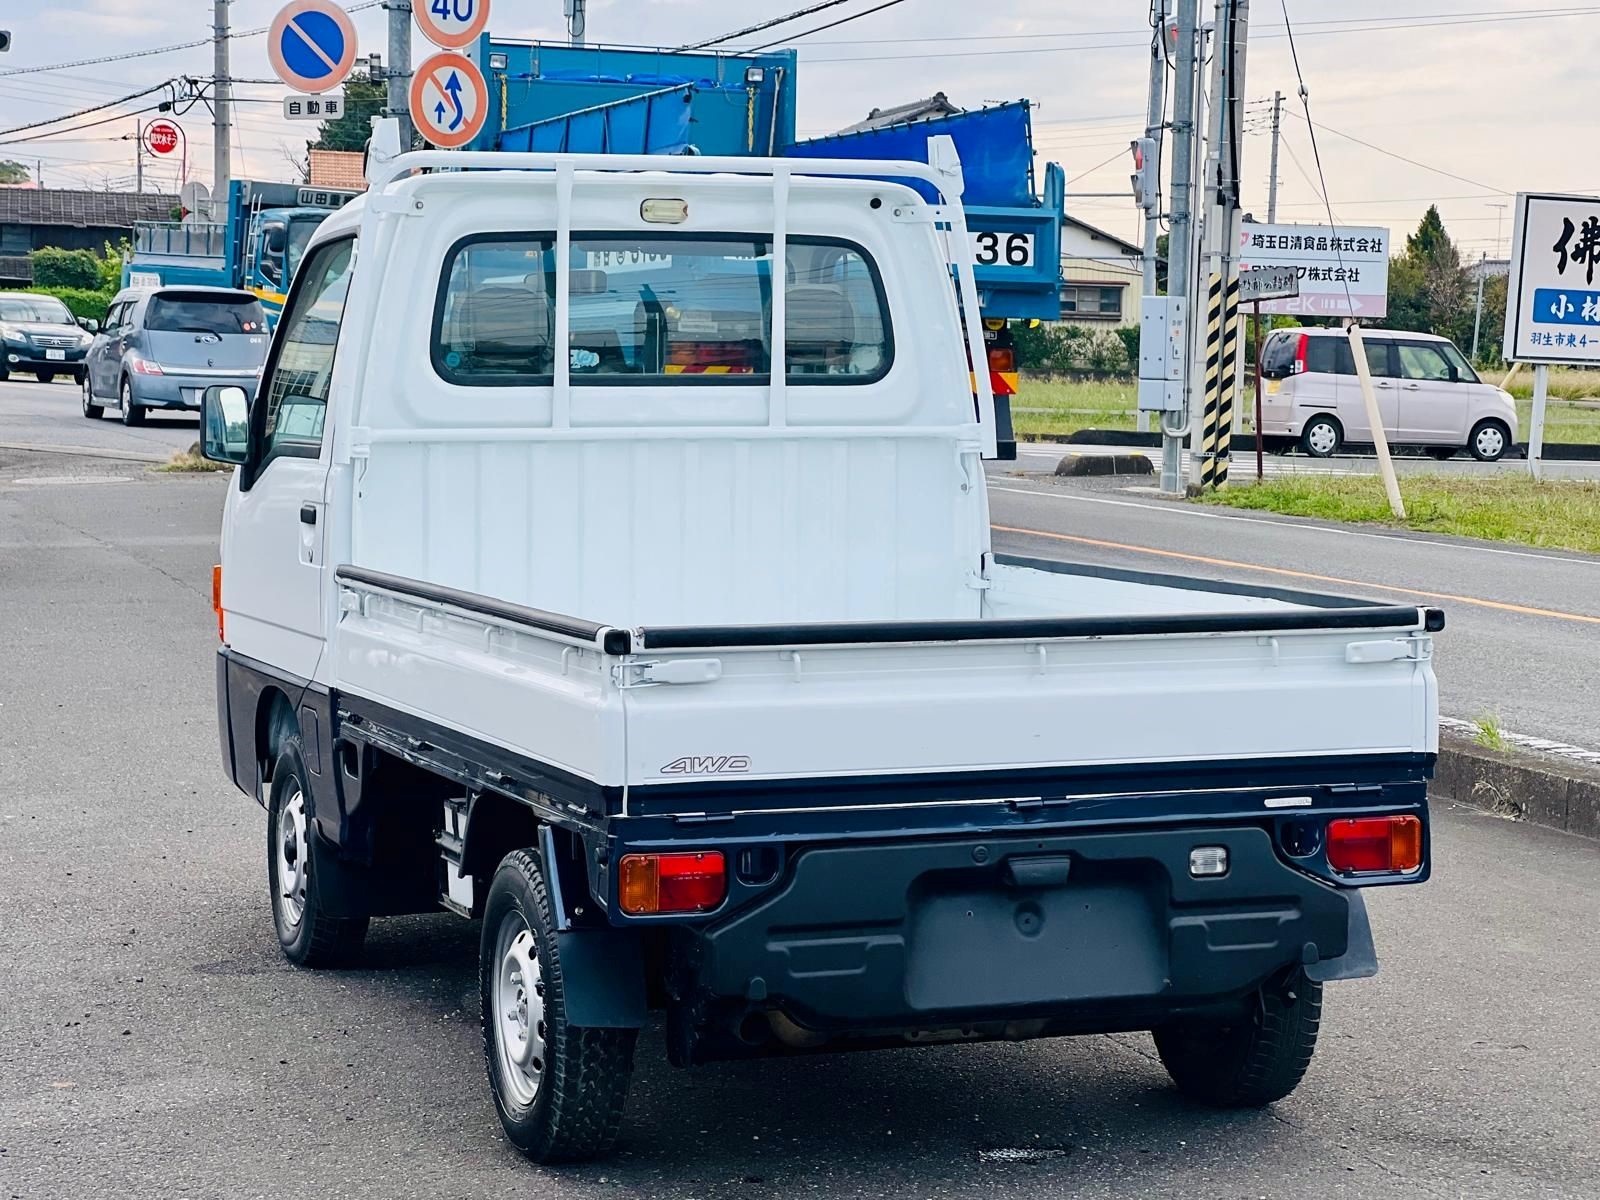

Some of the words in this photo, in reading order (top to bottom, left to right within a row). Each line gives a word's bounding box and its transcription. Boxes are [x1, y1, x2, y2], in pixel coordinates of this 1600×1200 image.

[432, 0, 473, 21] 40
[289, 100, 338, 115] 自動車
[975, 232, 1029, 266] 36
[1251, 233, 1382, 253] 埼玉日清食品株式会社
[1550, 294, 1600, 322] 小林
[660, 755, 752, 773] 4WD
